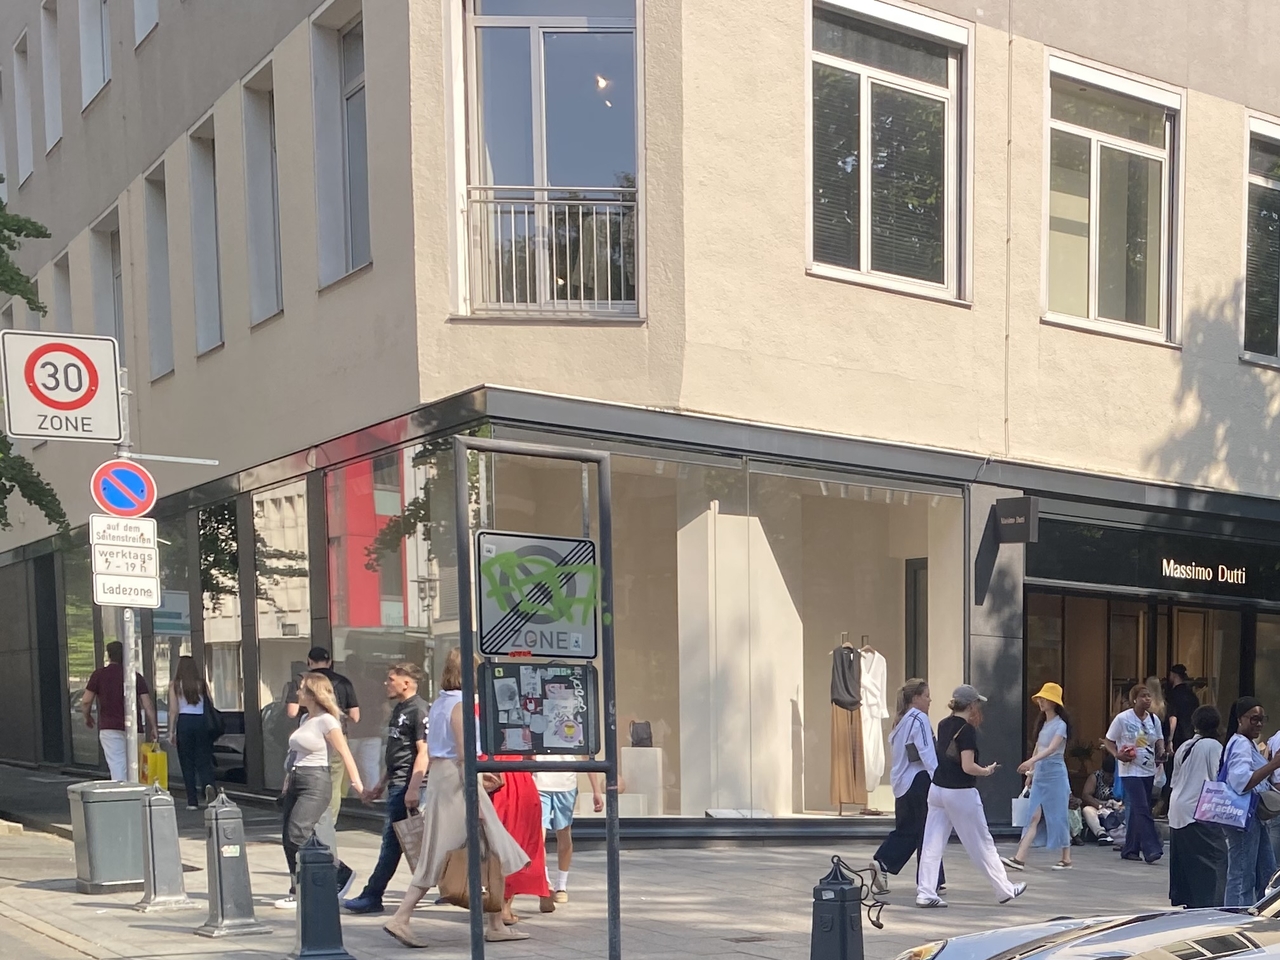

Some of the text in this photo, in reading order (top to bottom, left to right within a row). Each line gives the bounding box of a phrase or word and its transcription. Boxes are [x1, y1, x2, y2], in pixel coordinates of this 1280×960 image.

[40, 361, 83, 392] 30
[37, 414, 93, 432] ZONE
[106, 523, 140, 533] auf dem
[96, 531, 151, 544] Seitenstreifen
[98, 549, 153, 564] werktags
[125, 562, 136, 572] 19
[140, 563, 147, 573] h
[1162, 558, 1246, 584] Massimo Dutti
[102, 582, 153, 597] Ladezone
[511, 629, 568, 650] ZONE
